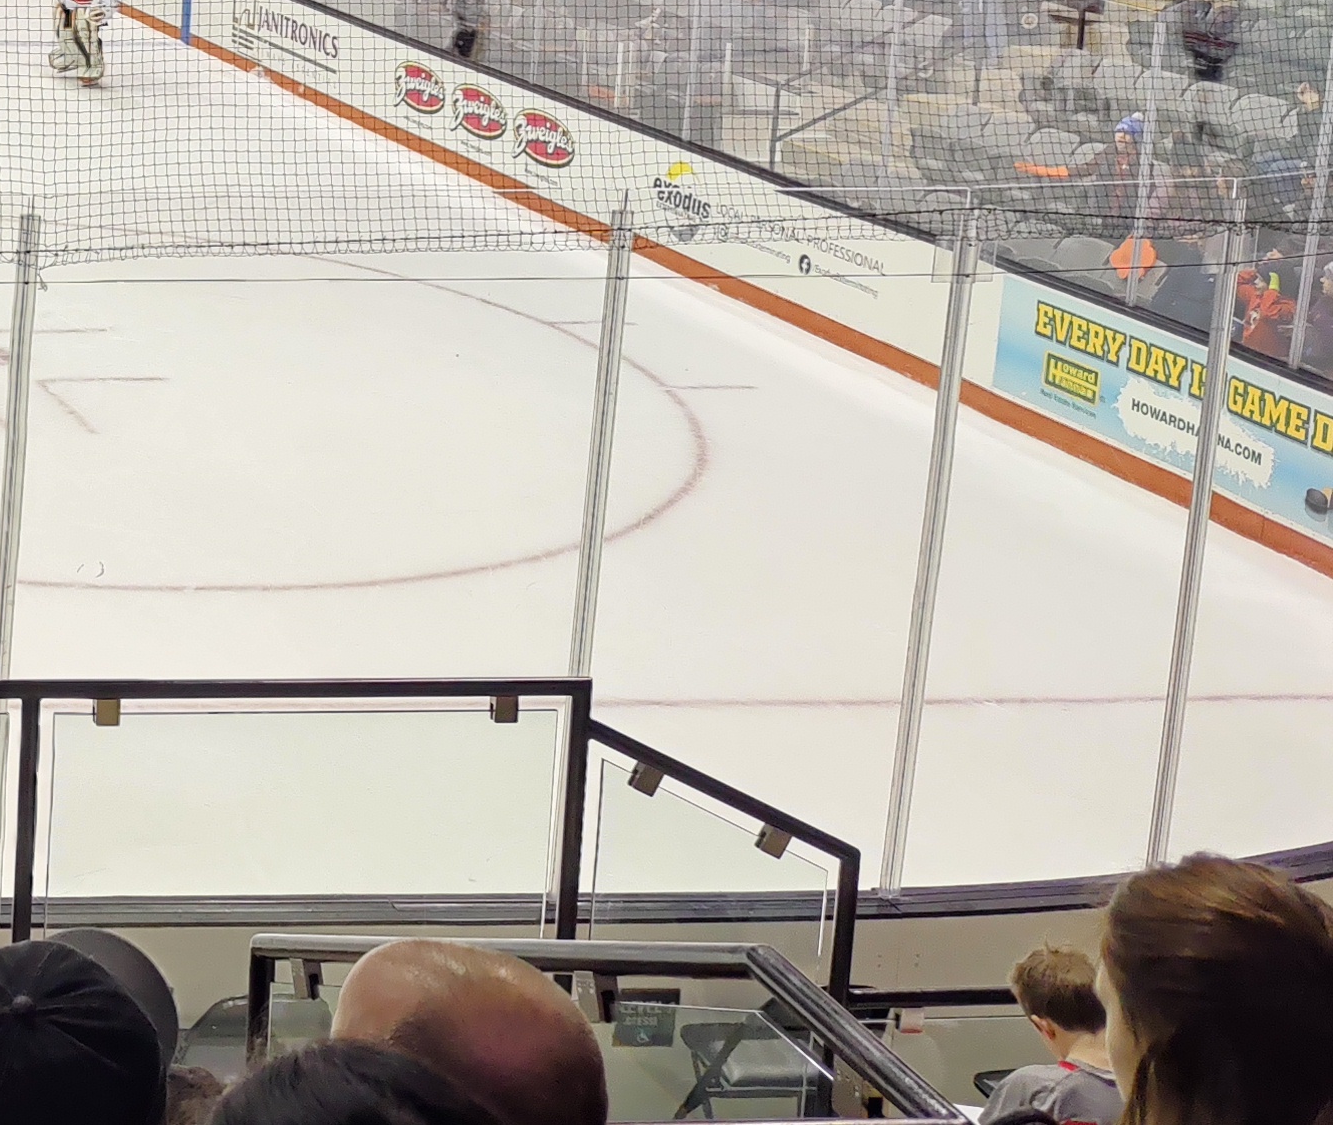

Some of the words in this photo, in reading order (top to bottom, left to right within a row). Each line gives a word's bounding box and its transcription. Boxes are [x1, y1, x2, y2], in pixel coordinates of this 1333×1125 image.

[258, 6, 338, 59] JANITRONICS
[808, 235, 886, 276] PROFESSIONAL
[1035, 300, 1126, 366] EVERY
[1127, 336, 1186, 391] DAY
[1227, 376, 1312, 442] GAME
[1049, 358, 1096, 385] Howard
[1131, 397, 1263, 466] HOWARDHNA.COM
